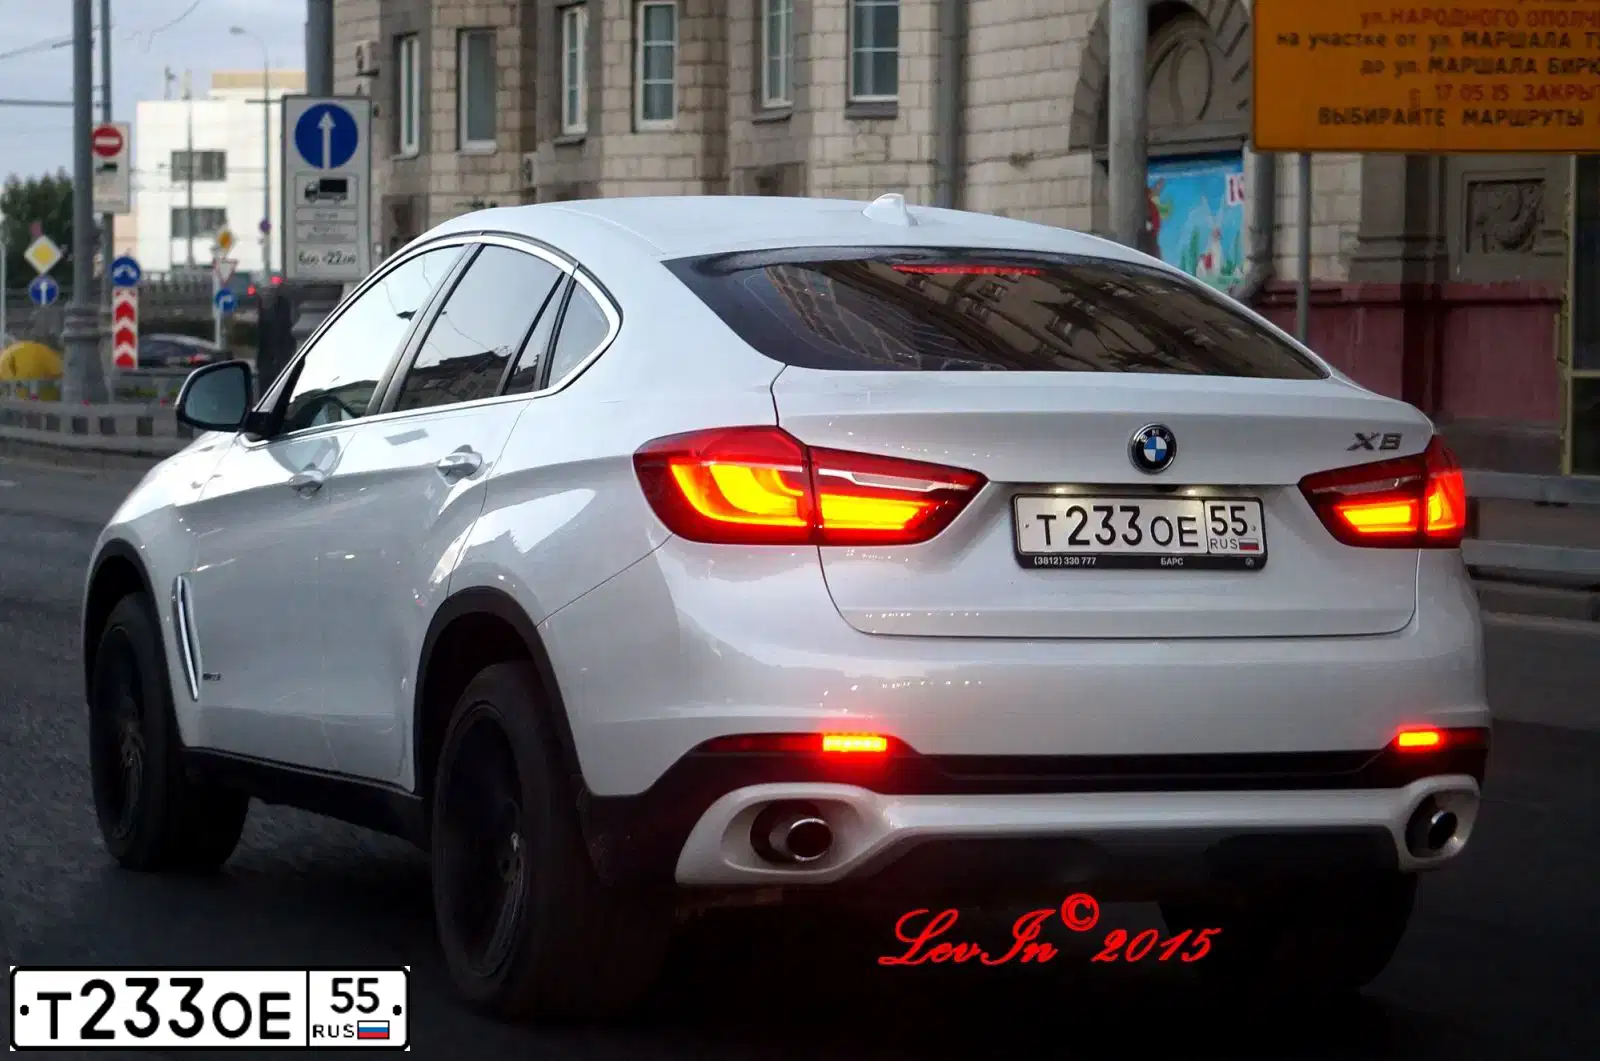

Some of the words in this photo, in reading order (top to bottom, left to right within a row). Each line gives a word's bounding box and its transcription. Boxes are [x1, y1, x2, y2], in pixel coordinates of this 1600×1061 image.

[1277, 32, 1300, 47] на
[1308, 32, 1387, 52] участке
[1395, 33, 1416, 47] от
[1461, 31, 1572, 49] МАРШАЛА
[1359, 59, 1386, 76] до
[1427, 55, 1538, 75] МАРШАЛА
[1317, 106, 1446, 126] ВЫБИРАЙТЕ
[1462, 107, 1585, 127] МАРШРУТЫ
[1209, 505, 1249, 537] 55
[1209, 538, 1239, 550] RUS
[1034, 556, 1062, 566] (3812)
[1063, 556, 1080, 566] 330
[1081, 556, 1097, 566] 777
[1160, 557, 1184, 566] БАРС
